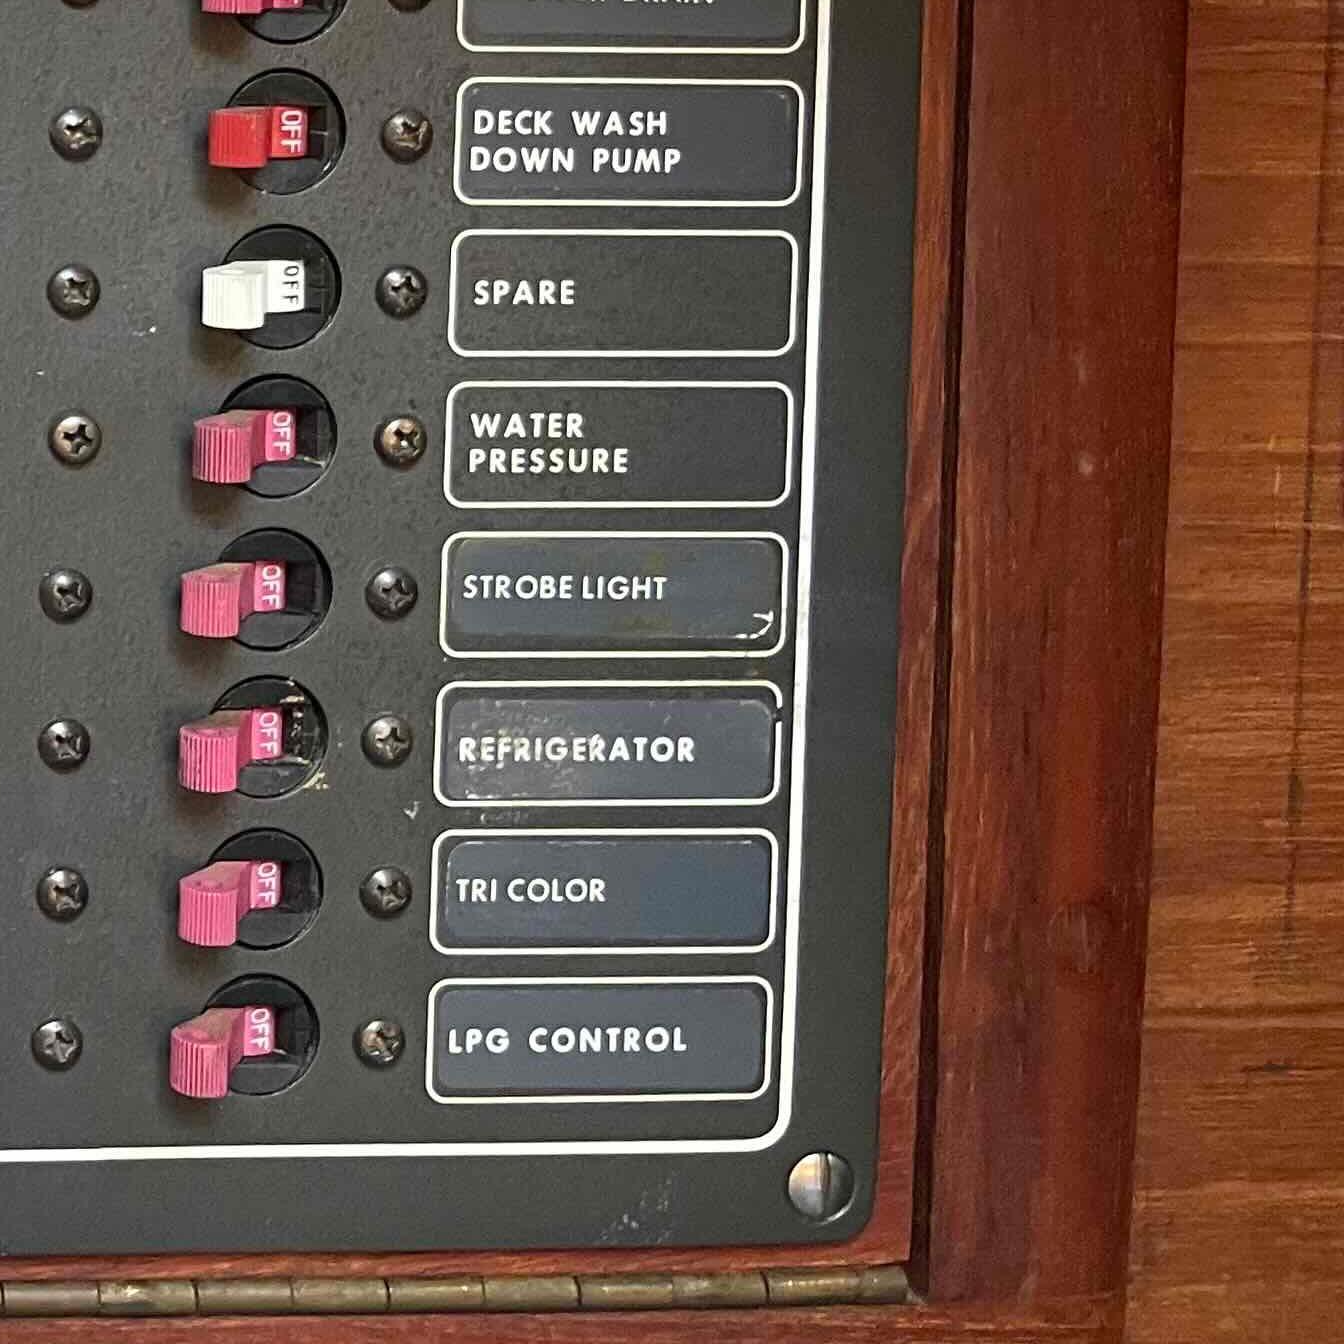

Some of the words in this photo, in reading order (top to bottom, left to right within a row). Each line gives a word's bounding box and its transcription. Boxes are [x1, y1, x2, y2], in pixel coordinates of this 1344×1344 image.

[282, 111, 301, 153] OFF
[473, 110, 552, 136] DECK
[572, 110, 667, 136] WASH
[470, 147, 574, 173] DOWN
[592, 148, 681, 174] PUMP
[285, 264, 299, 305] OFF
[473, 280, 576, 306] SPARE
[471, 412, 583, 438] WATER
[469, 449, 629, 473] PRESSURE
[462, 575, 572, 599] STROBE
[581, 576, 667, 600] LIGHT
[458, 735, 695, 763] REFRIGERATOR
[456, 878, 498, 902] TRI
[507, 878, 605, 903] COLOR
[447, 1028, 509, 1054] LPG
[528, 1026, 687, 1053] CONTROL
